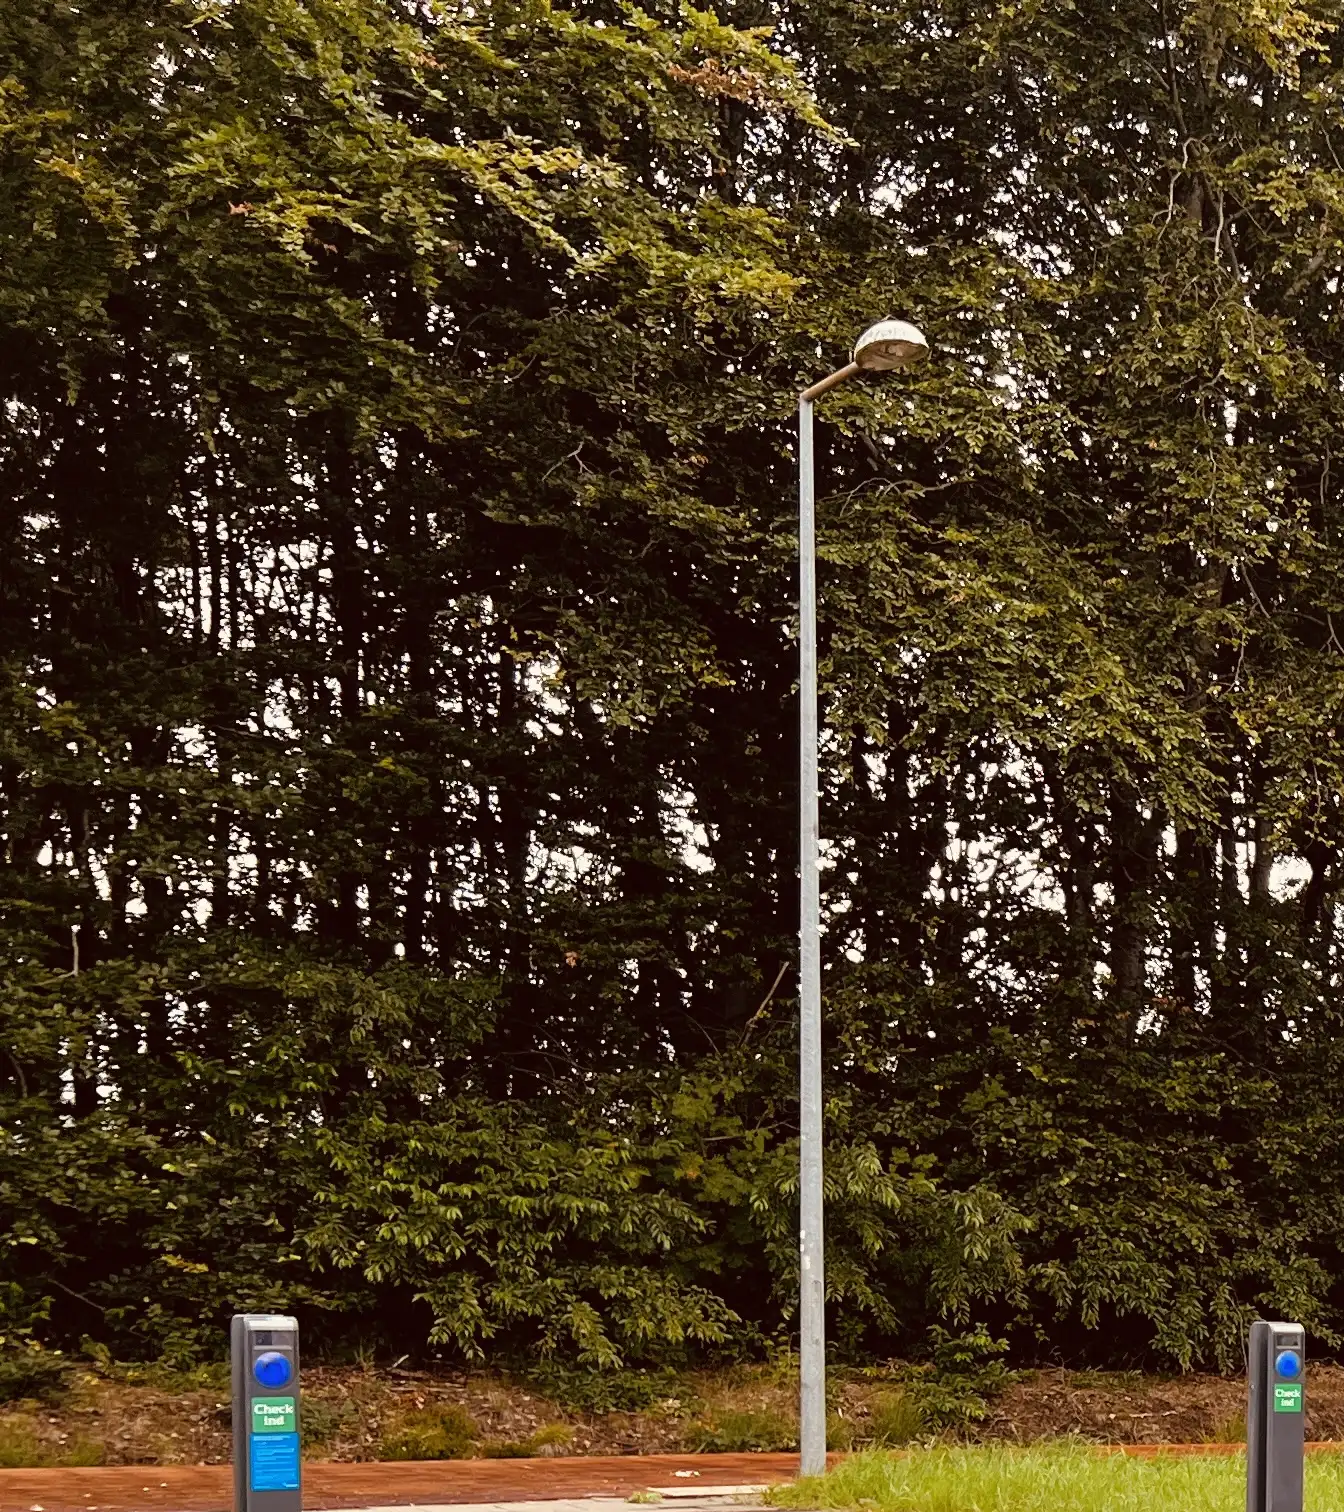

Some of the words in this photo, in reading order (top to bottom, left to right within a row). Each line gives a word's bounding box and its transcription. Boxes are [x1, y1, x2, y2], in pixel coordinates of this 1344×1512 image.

[1275, 1388, 1300, 1397] Check
[253, 1403, 293, 1414] Check
[263, 1415, 284, 1425] ind
